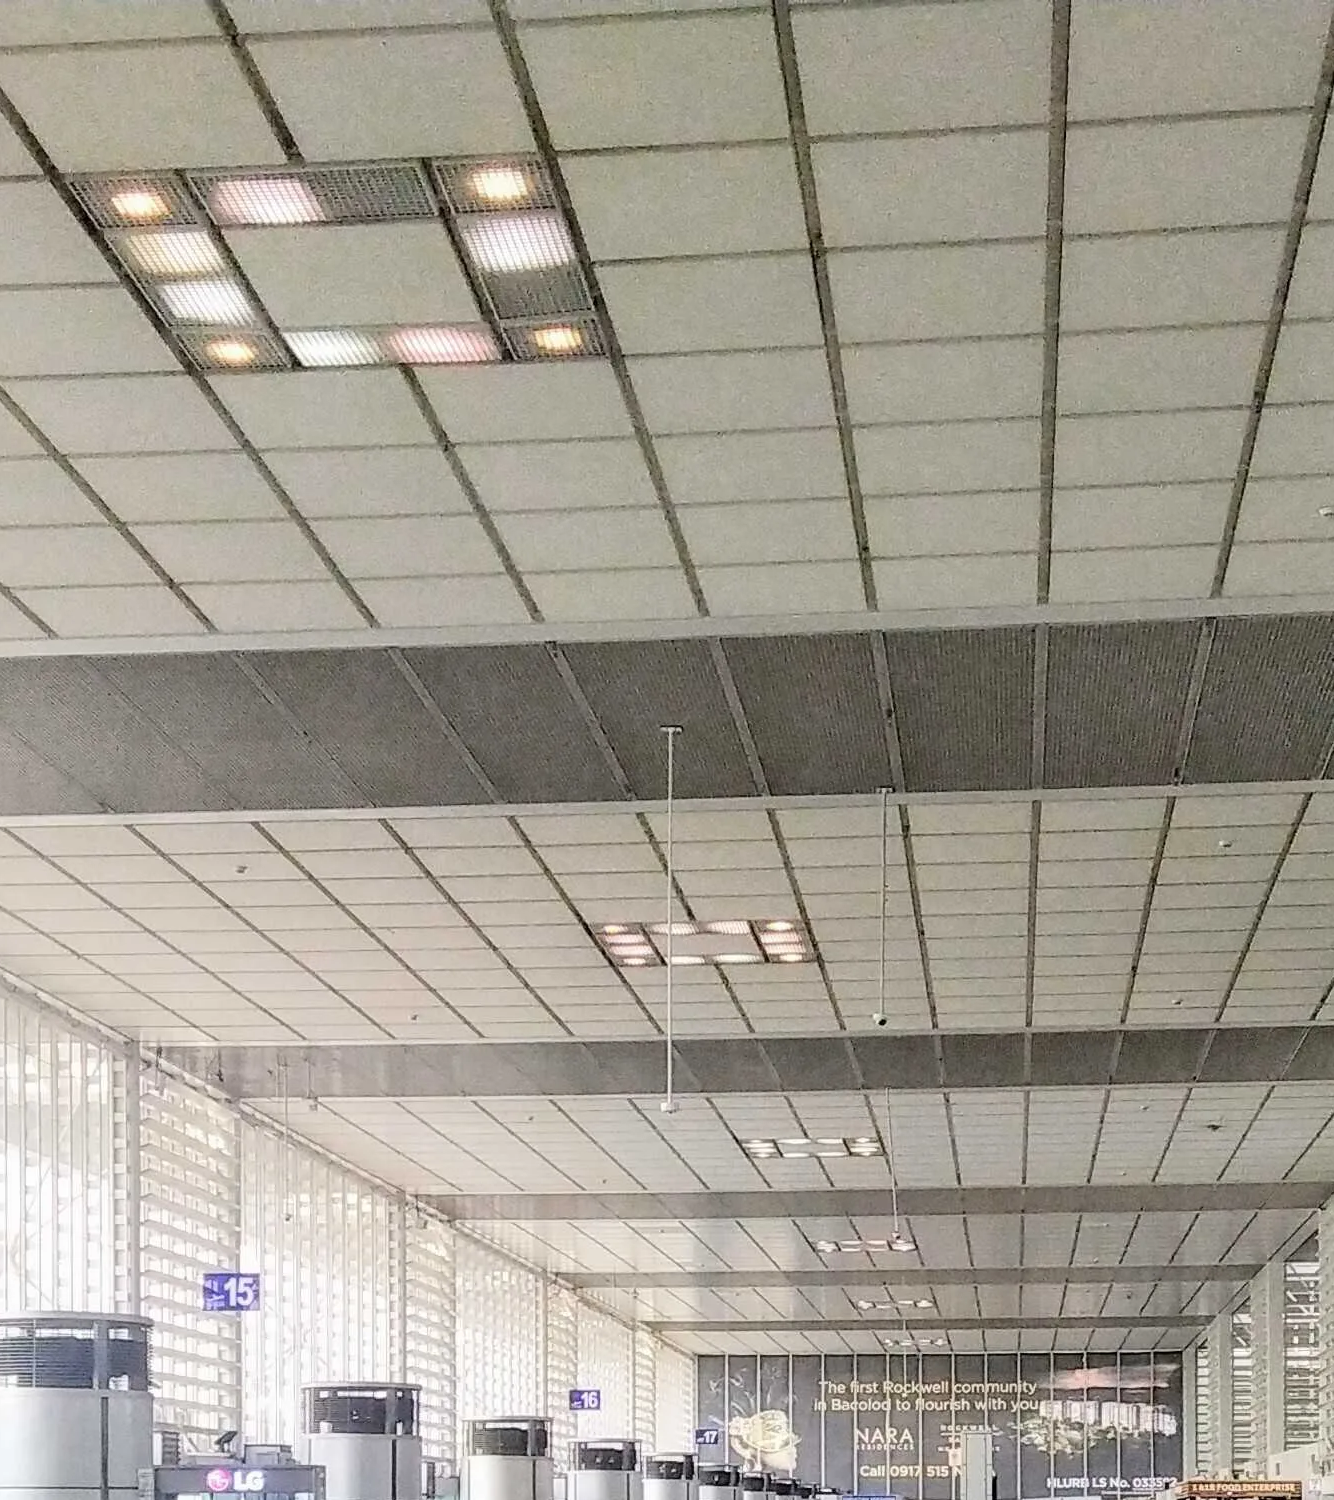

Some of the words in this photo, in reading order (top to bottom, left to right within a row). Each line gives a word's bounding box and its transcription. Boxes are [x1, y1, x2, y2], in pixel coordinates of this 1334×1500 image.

[224, 1277, 255, 1306] 15
[818, 1381, 846, 1394] The
[850, 1381, 880, 1394] first
[883, 1381, 949, 1394] Rockwell
[954, 1382, 1037, 1397] community
[581, 1391, 598, 1408] 16
[814, 1398, 827, 1411] in
[831, 1398, 891, 1411] Bacolod
[896, 1400, 910, 1411] to
[914, 1398, 971, 1412] flourish
[974, 1398, 1007, 1411] with
[704, 1430, 718, 1443] 17
[855, 1427, 914, 1443] NARA
[860, 1465, 886, 1478] Call
[891, 1466, 921, 1478] 0917
[926, 1466, 949, 1478] 515
[233, 1470, 265, 1491] LG
[1092, 1477, 1108, 1488] LS
[1110, 1477, 1131, 1488] No.
